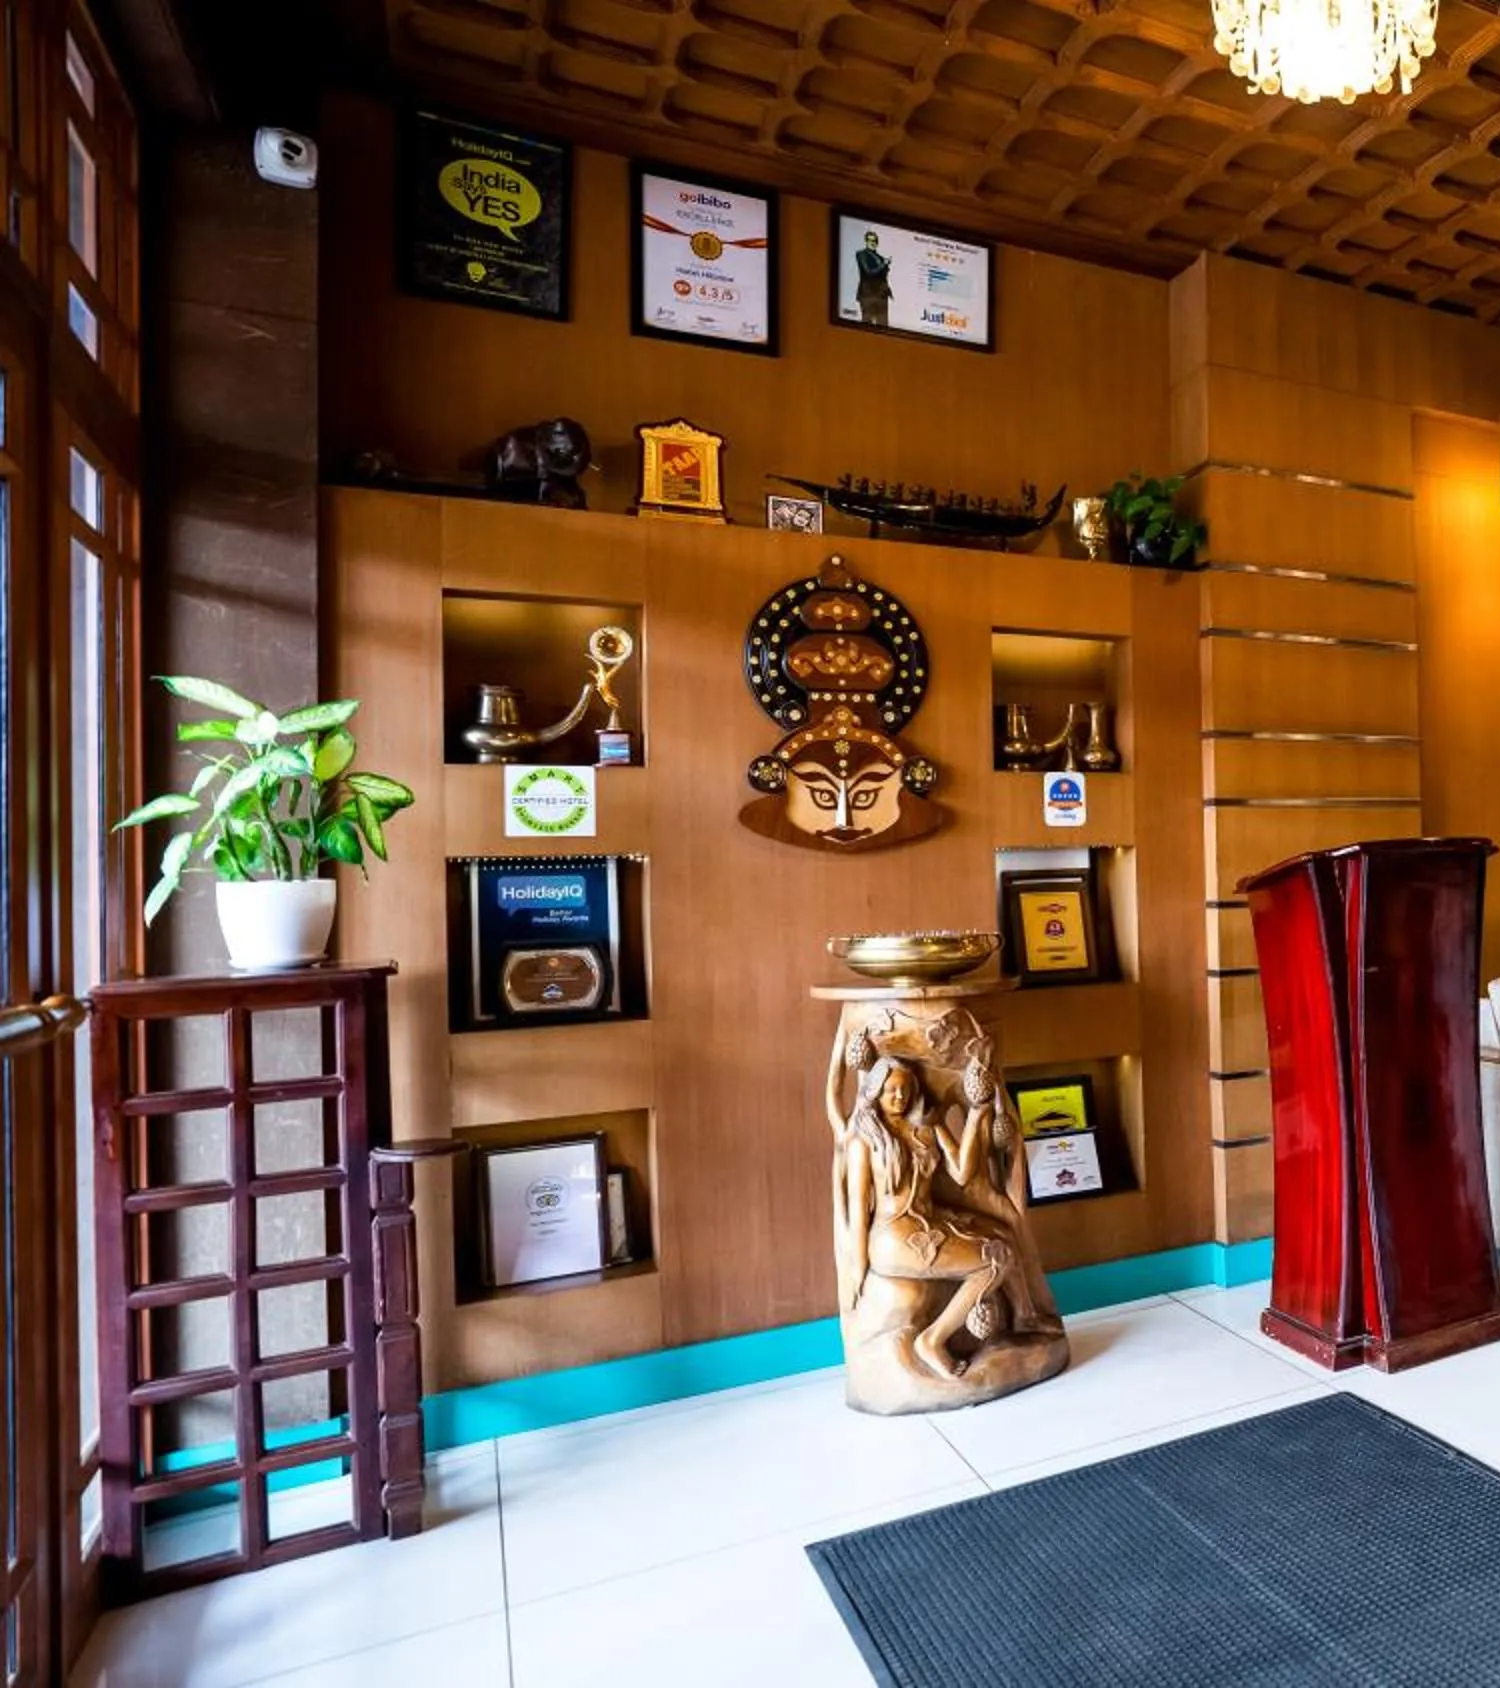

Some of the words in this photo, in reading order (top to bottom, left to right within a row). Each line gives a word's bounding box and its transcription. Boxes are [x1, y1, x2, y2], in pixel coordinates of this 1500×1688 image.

[462, 163, 521, 195] India
[463, 192, 521, 223] YES
[679, 191, 732, 211] goibibo
[559, 797, 590, 805] HOTEL
[501, 884, 583, 901] HolidayIQ
